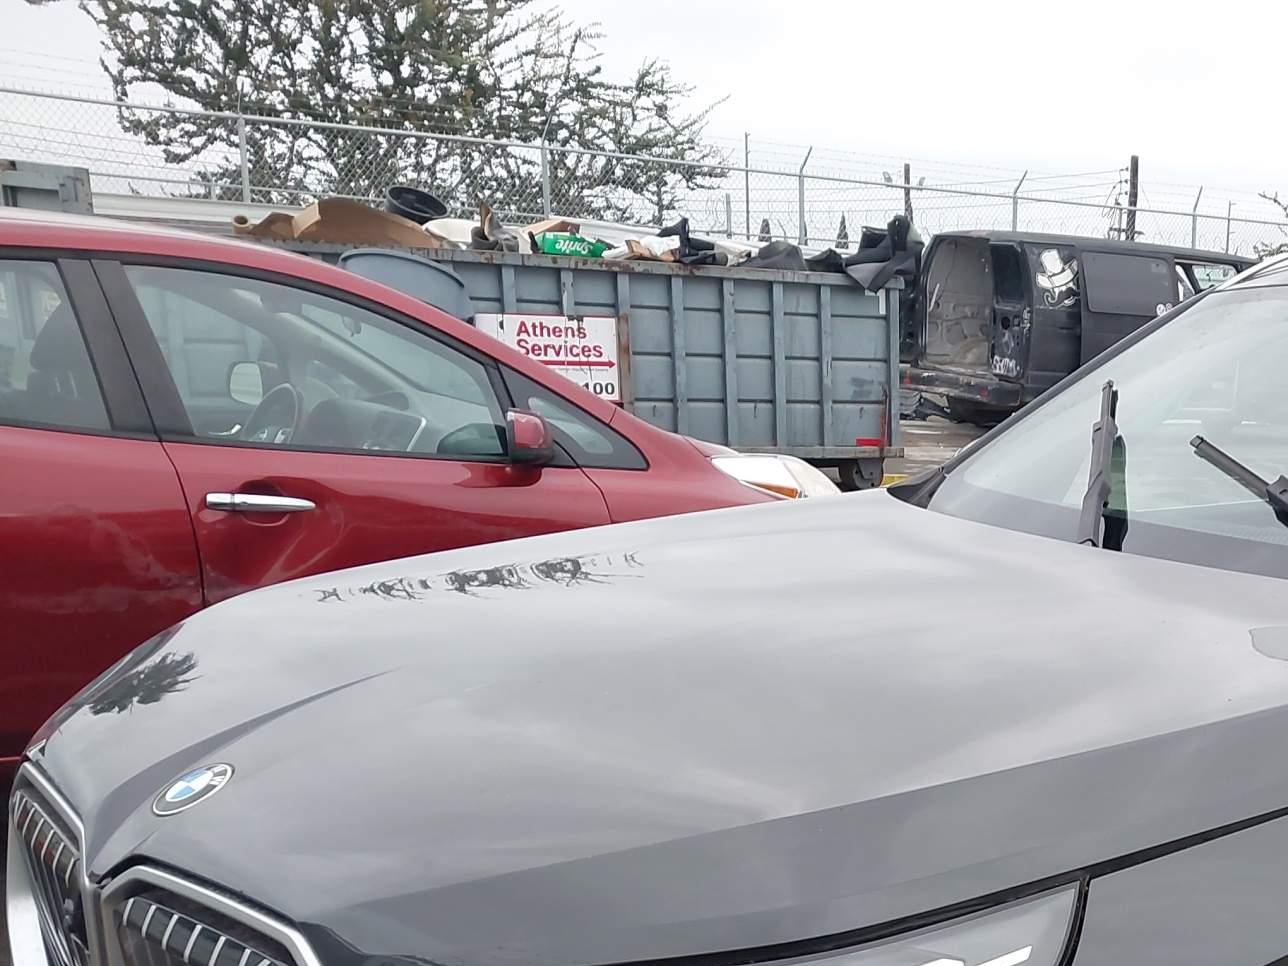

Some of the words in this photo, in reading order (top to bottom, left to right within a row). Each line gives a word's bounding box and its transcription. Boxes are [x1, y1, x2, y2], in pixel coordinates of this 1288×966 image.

[555, 240, 593, 255] Sprite
[516, 320, 587, 339] Athens
[516, 339, 603, 358] Services
